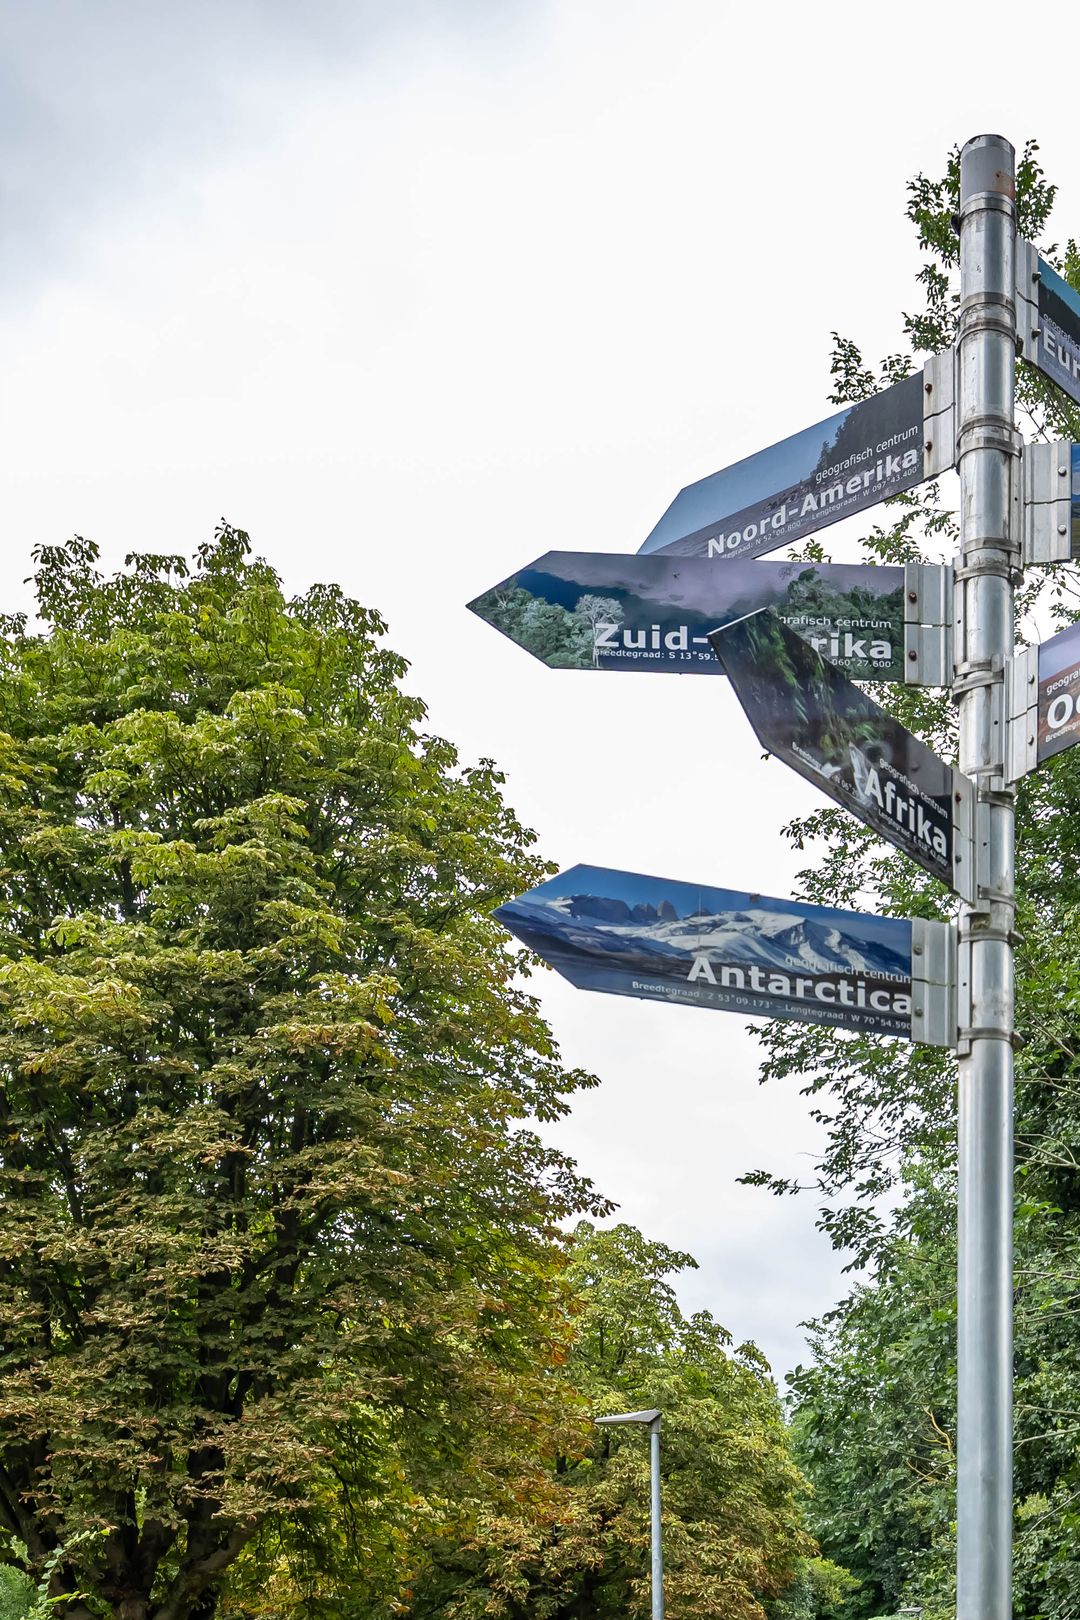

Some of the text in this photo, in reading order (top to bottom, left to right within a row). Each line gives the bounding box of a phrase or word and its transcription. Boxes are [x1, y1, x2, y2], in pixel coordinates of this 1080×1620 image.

[815, 425, 918, 483] geografisch centrum
[708, 448, 918, 558] Noord-Amerika
[836, 618, 892, 629] centrum
[865, 767, 947, 857] Afrika
[879, 757, 920, 795] geografisch
[920, 791, 948, 819] centrum
[686, 956, 912, 1015] Antarctica
[784, 954, 862, 976] geografisch
[632, 980, 705, 999] Breedtegraad:
[785, 1004, 848, 1021] Lengtegraad:
